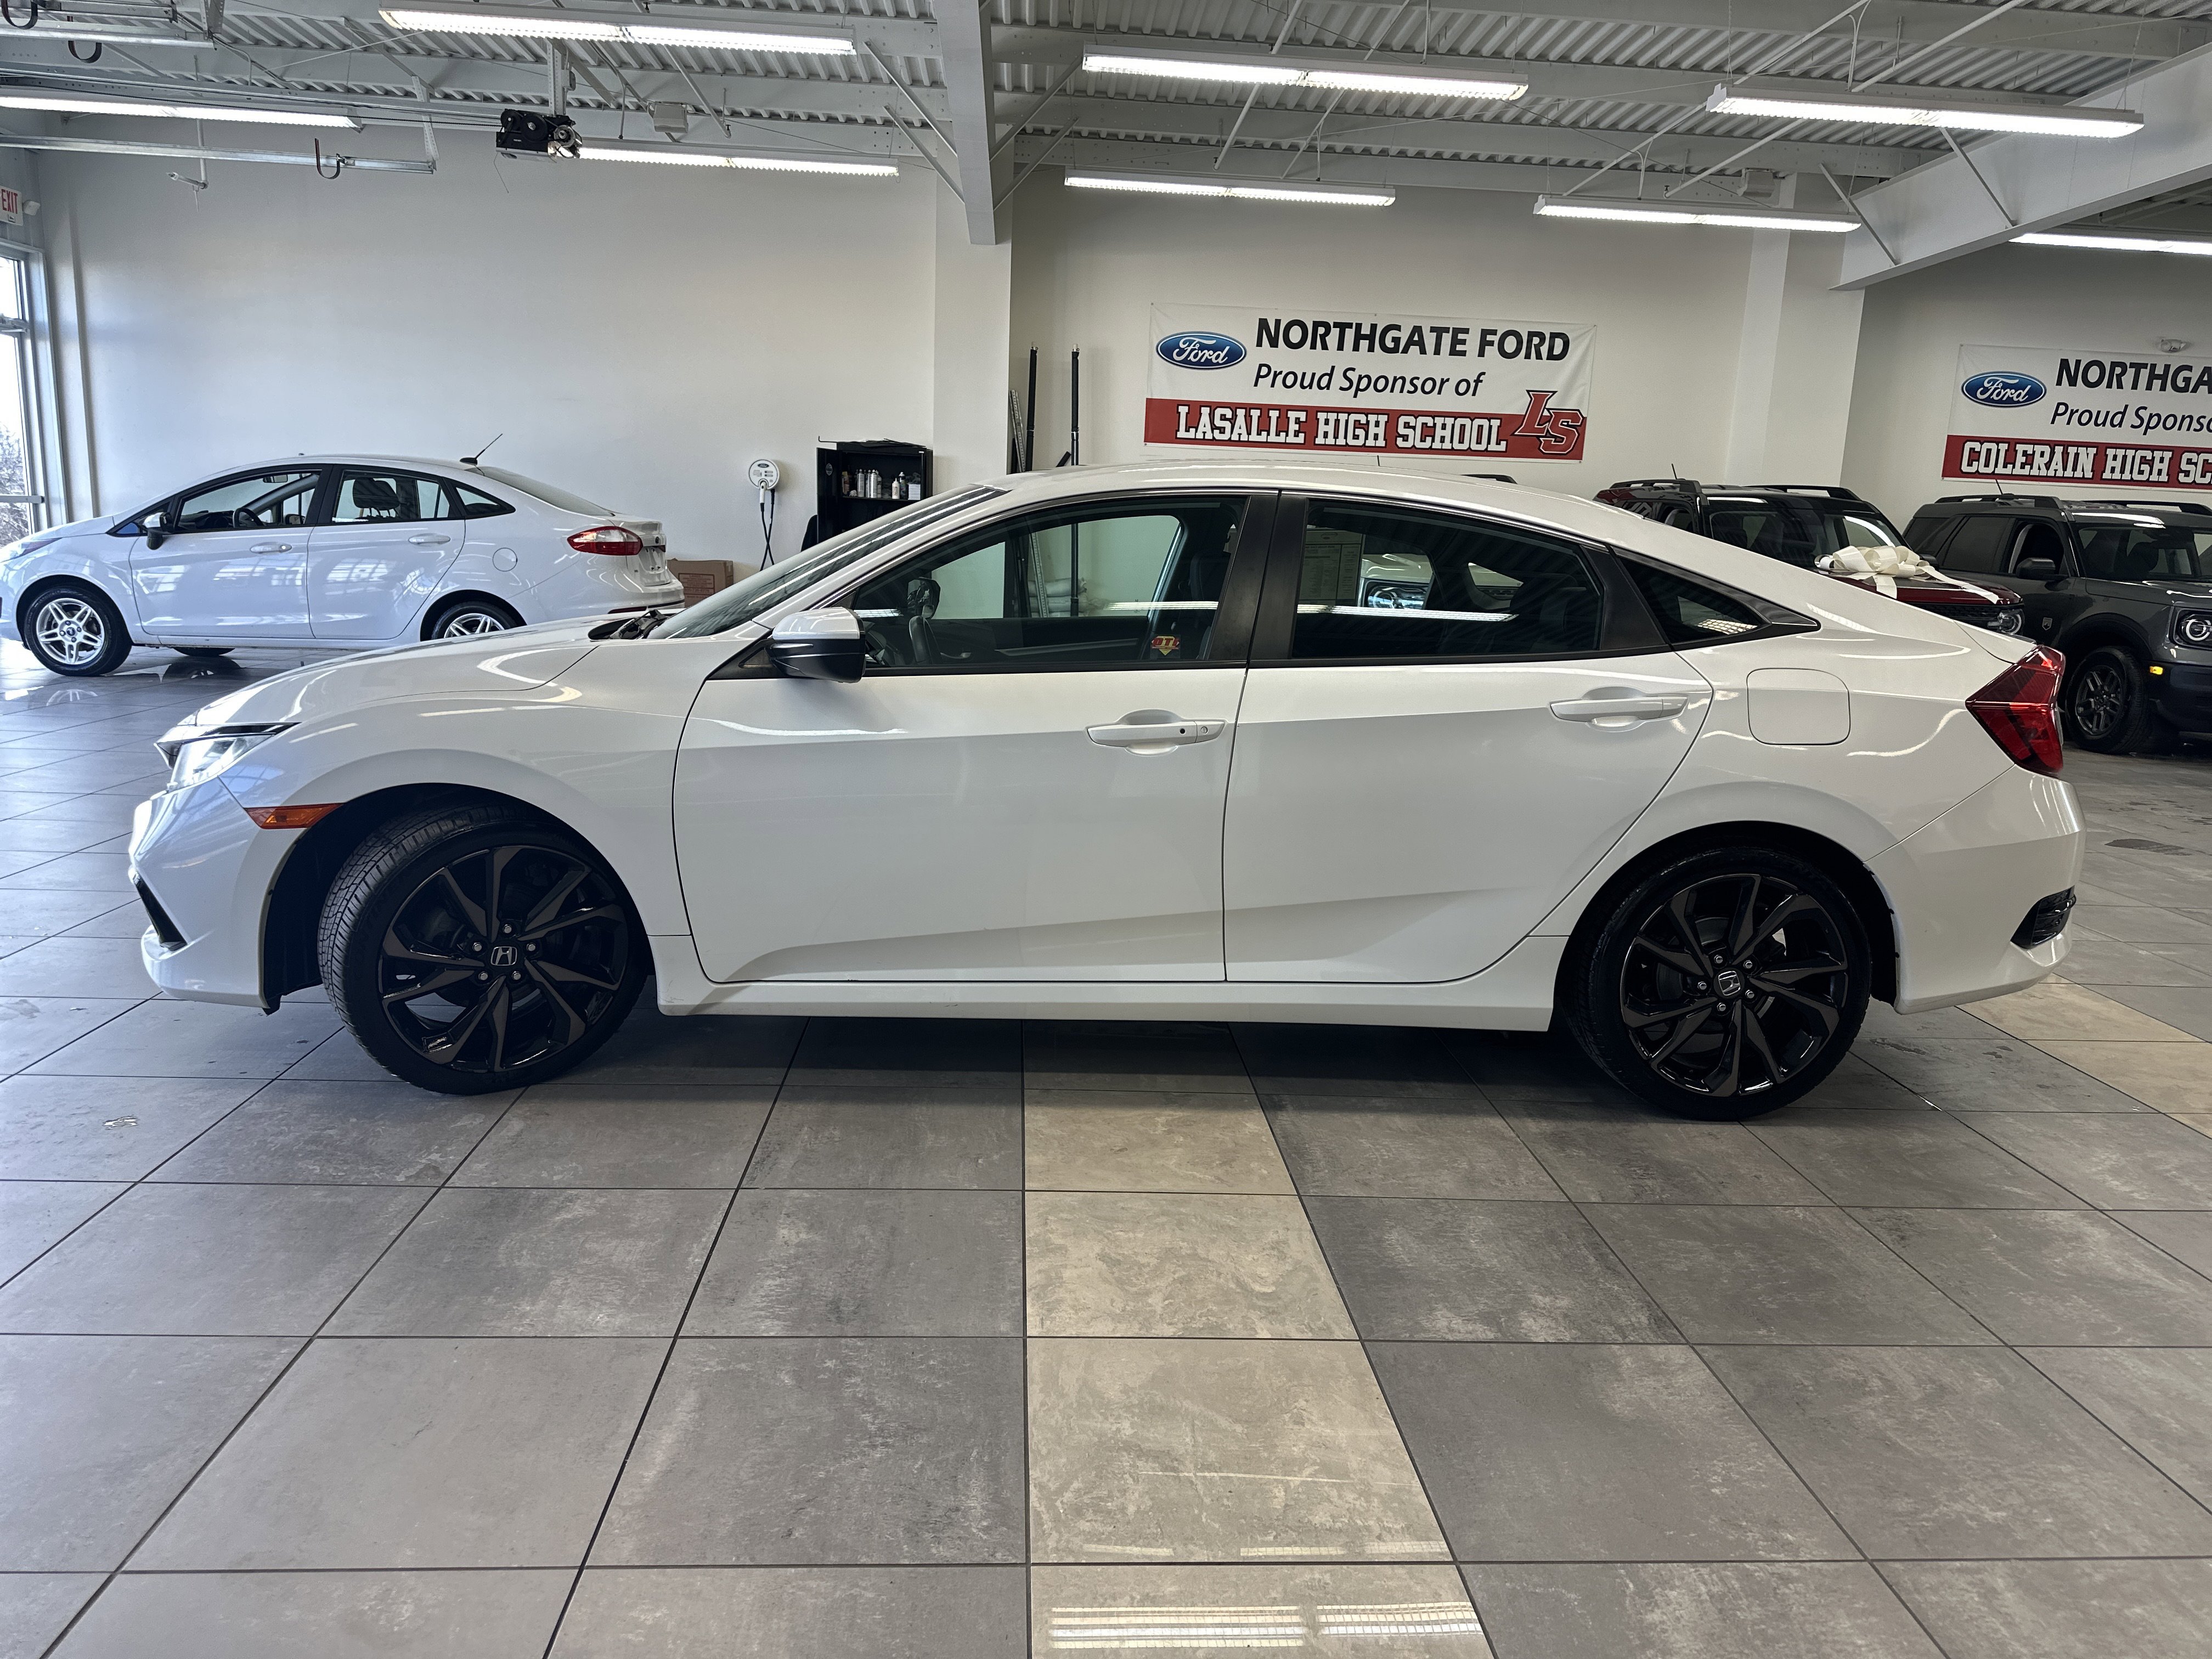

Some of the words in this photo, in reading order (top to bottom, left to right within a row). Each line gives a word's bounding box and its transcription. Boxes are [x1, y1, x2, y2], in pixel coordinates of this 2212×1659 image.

[2, 189, 18, 214] EXIT
[1172, 337, 1229, 364] Ford
[1255, 317, 1470, 357] NORTHGATE
[1477, 328, 1570, 361] FORD
[1253, 363, 1336, 391] Proud
[1340, 367, 1450, 398] Sponsor
[1454, 371, 1487, 397] of
[1976, 376, 2032, 402] Ford
[2055, 358, 2212, 394] NORTHGA
[1176, 405, 1307, 444] LASALLE
[1314, 411, 1389, 447] HIGH
[1396, 415, 1507, 452] SCHOOL
[1510, 390, 1585, 455] LS
[2050, 402, 2129, 428] Proud
[1960, 441, 2098, 479] COLERAIN
[2102, 447, 2174, 482] HIGH
